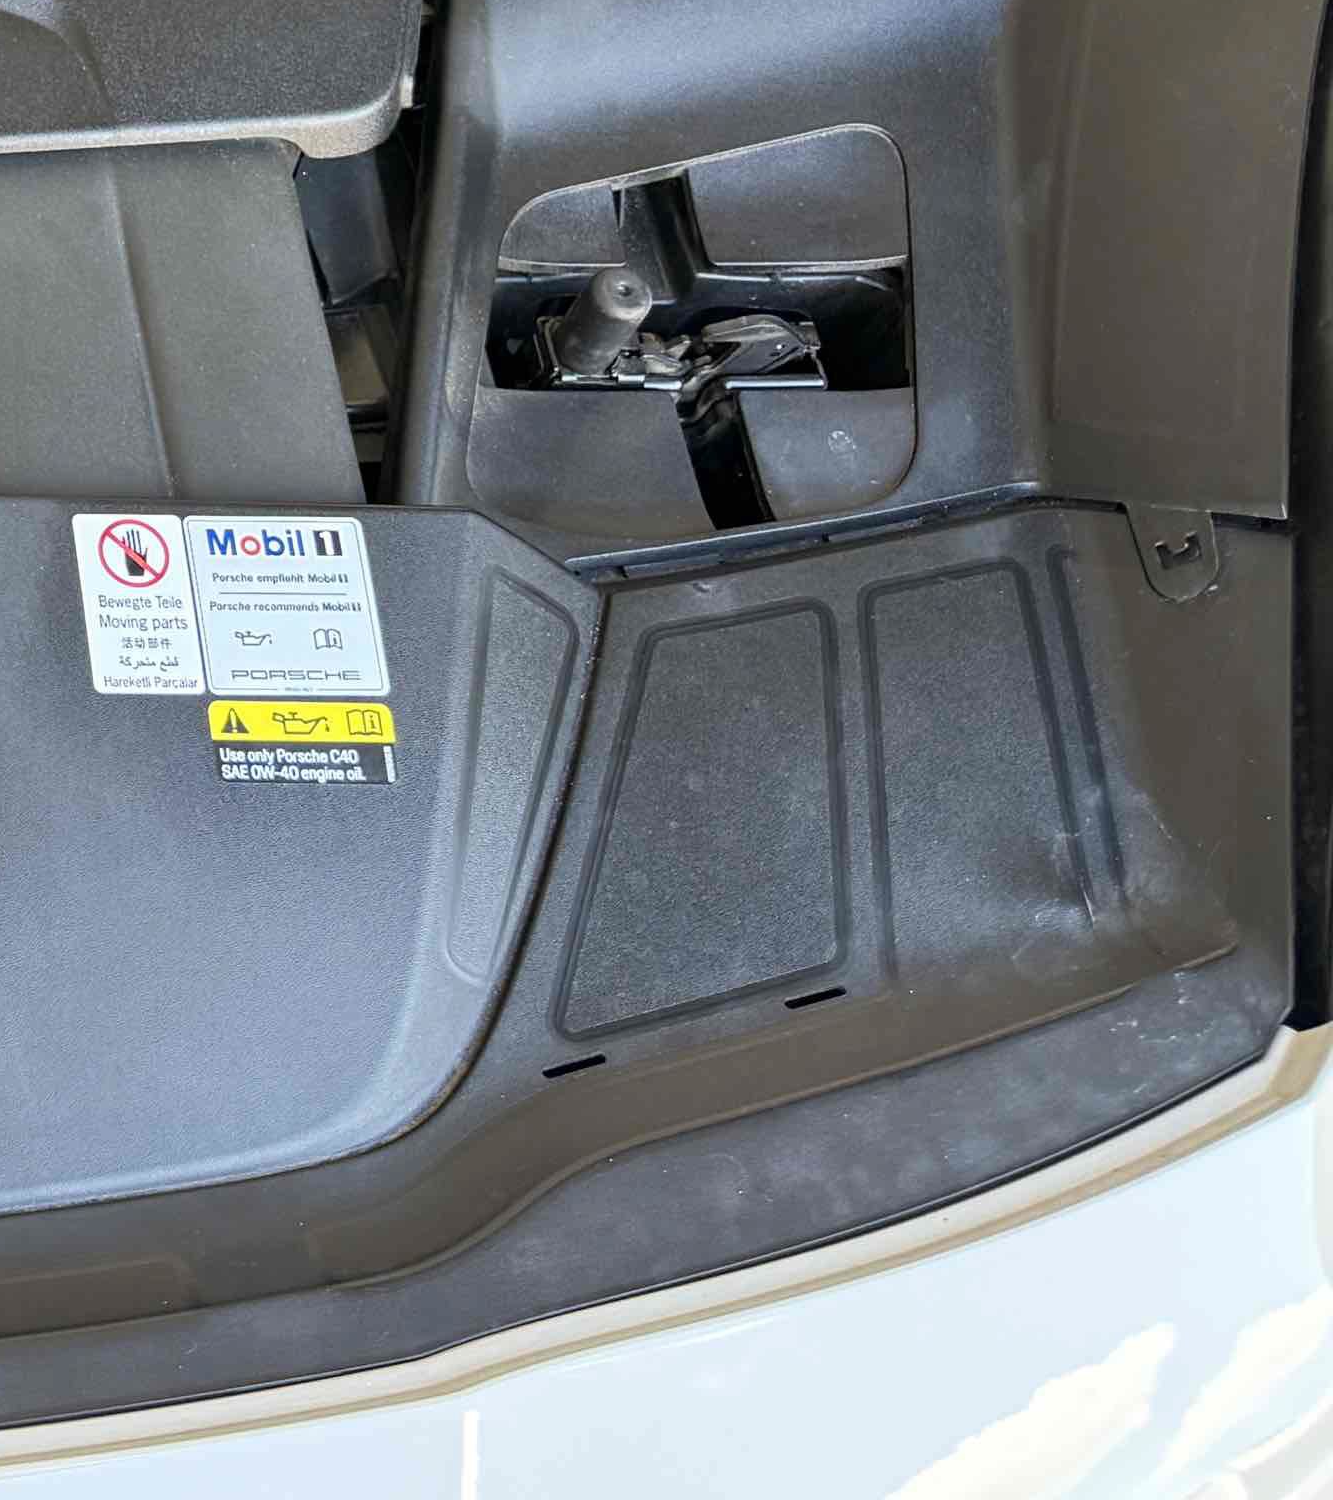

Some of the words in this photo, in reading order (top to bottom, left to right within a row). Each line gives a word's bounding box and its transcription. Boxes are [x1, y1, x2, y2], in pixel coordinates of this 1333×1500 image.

[206, 529, 305, 556] Mobil
[316, 530, 339, 556] 1
[212, 573, 253, 583] Porsche
[257, 574, 303, 585] empfiehlt
[308, 574, 336, 583] Mobil
[98, 594, 152, 610] Bewegte
[155, 595, 182, 608] Teile
[210, 601, 250, 611] Porsche
[254, 602, 319, 611] recommends
[323, 601, 350, 611] Mobil
[99, 613, 148, 631] Moving
[153, 616, 188, 631] parts
[103, 676, 152, 688] Hareketli
[231, 670, 362, 681] PORSCHE
[219, 748, 245, 762] Use
[247, 748, 274, 764] only
[276, 749, 328, 763] Porsche
[330, 750, 359, 764] C40
[221, 765, 250, 779] SAE
[250, 765, 299, 780] 0W-40
[300, 767, 344, 783] engine
[346, 766, 367, 781] oil.
